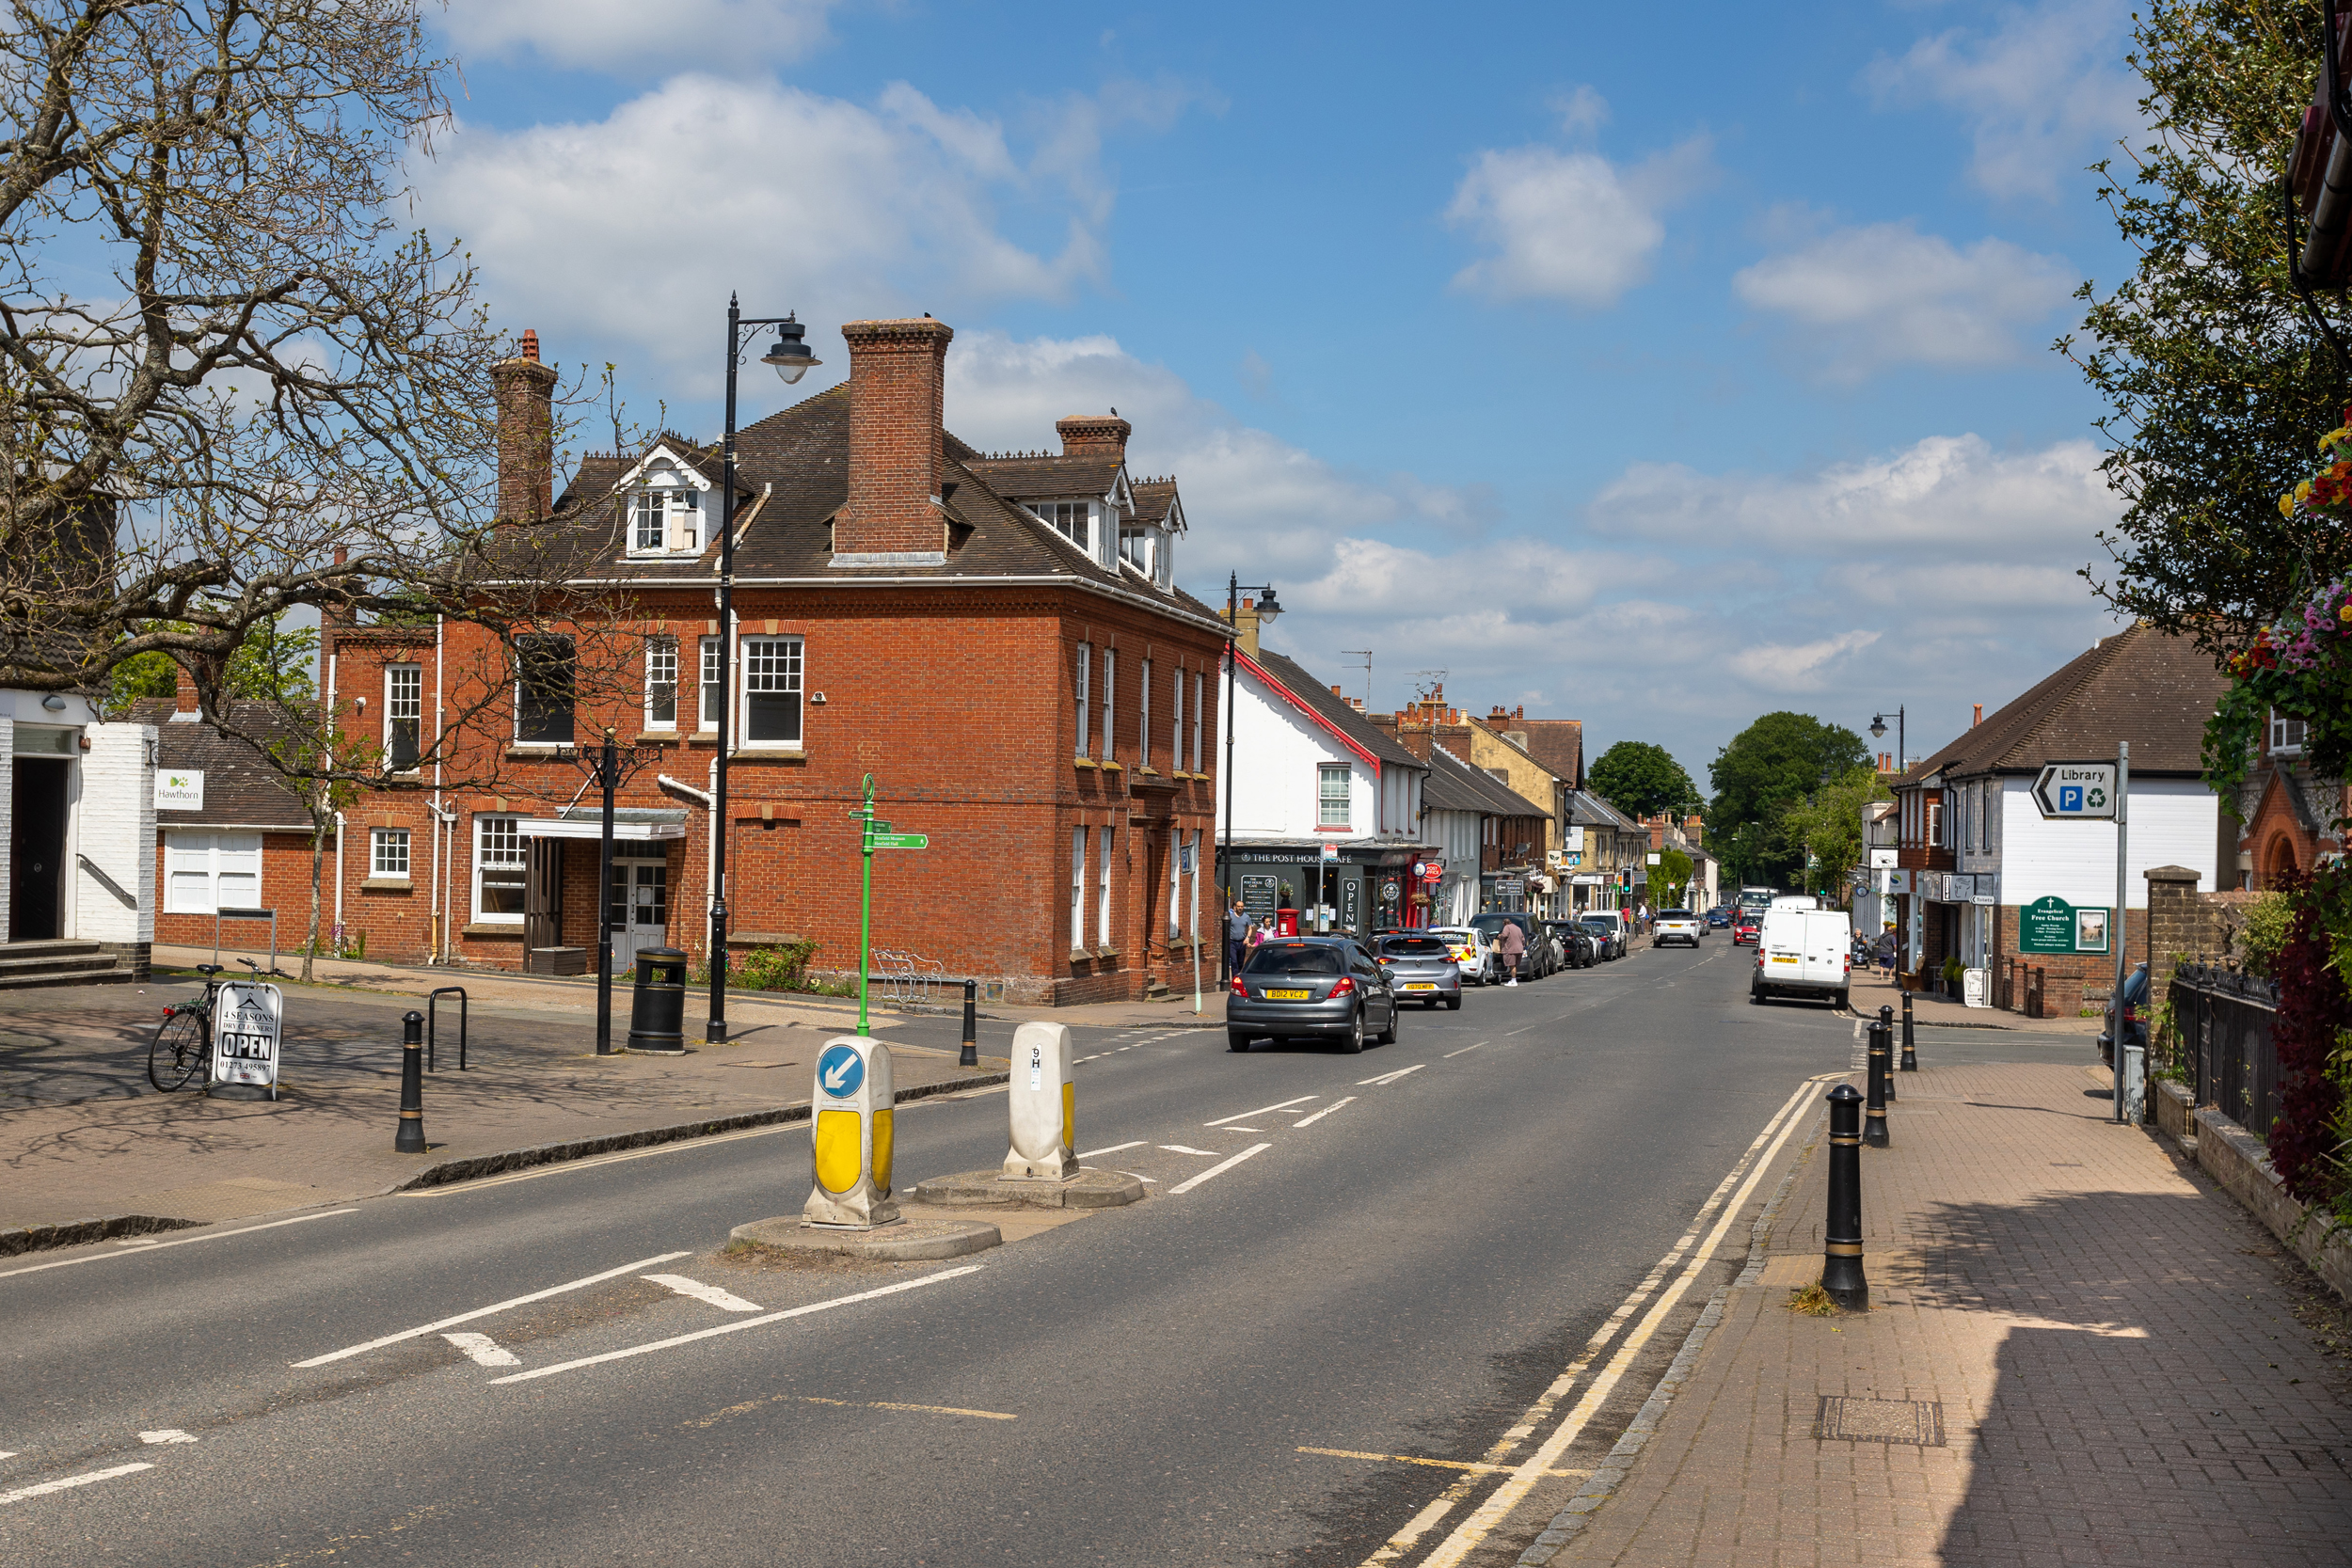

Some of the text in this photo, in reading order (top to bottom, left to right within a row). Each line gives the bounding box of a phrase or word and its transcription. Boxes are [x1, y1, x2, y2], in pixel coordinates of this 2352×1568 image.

[2062, 769, 2105, 782] Library
[159, 789, 198, 799] Hawthorn
[2065, 790, 2077, 807] P
[1272, 854, 1294, 862] POST
[1346, 882, 1356, 922] OPEN
[231, 1011, 274, 1022] SEASONS
[238, 1023, 273, 1032] CLEANERS
[223, 1034, 271, 1059] OPEN
[1033, 1048, 1039, 1058] 9
[220, 1061, 270, 1071] 01273 495897
[1032, 1059, 1040, 1068] H
